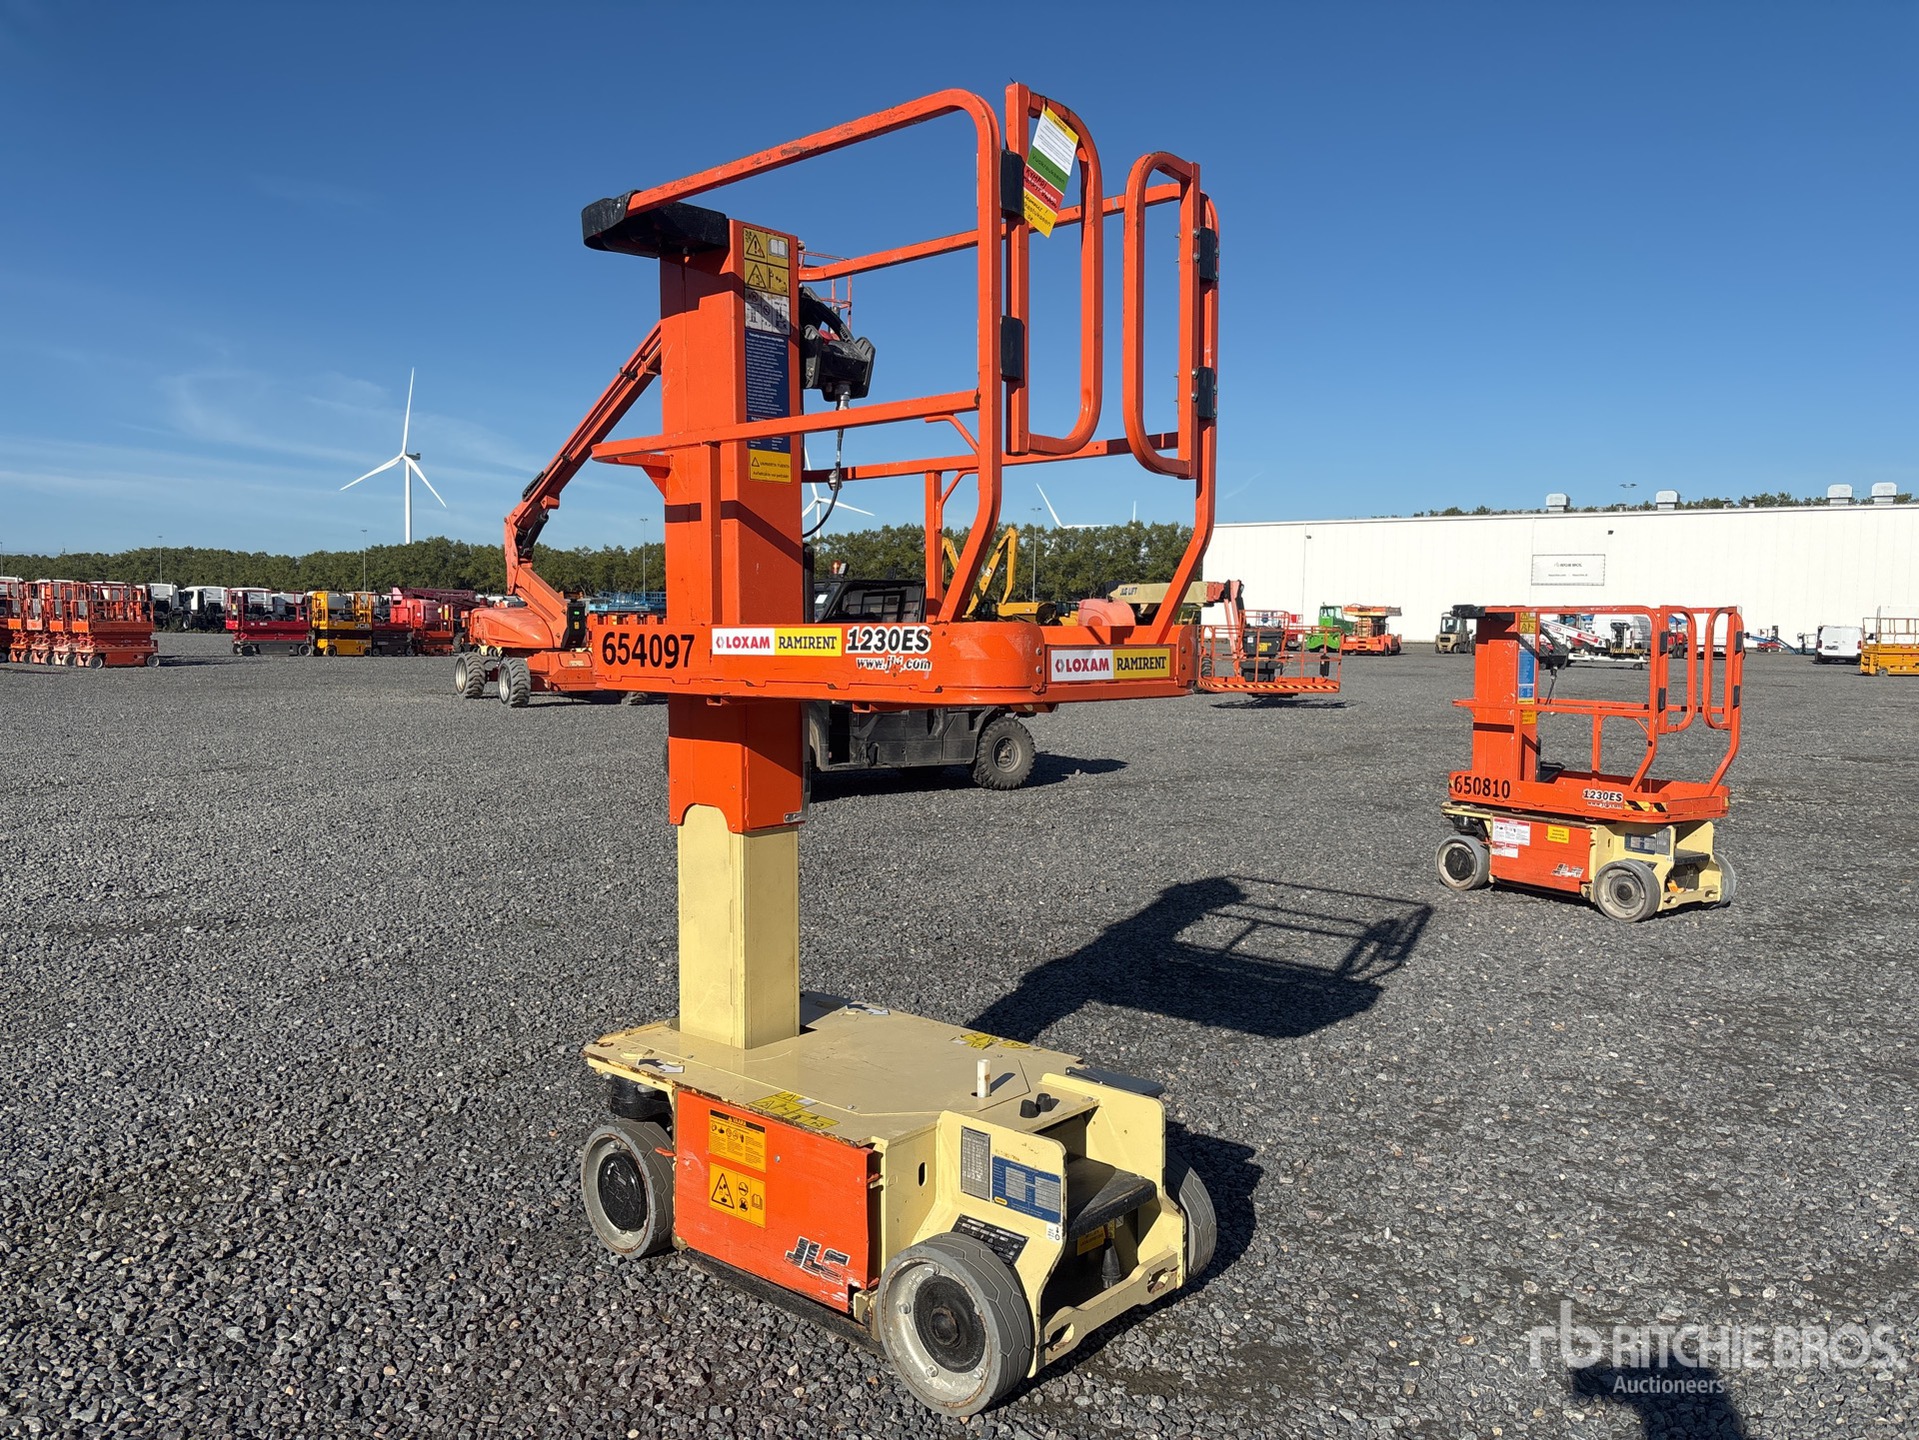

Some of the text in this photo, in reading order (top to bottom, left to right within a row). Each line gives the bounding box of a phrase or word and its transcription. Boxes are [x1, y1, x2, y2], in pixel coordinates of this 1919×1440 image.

[602, 631, 695, 669] 654097
[725, 635, 838, 650] LOXAM RAMIRENT
[847, 628, 931, 652] 1230ES
[1066, 656, 1167, 672] LOXAM RAMIRENT
[1454, 775, 1511, 799] 650810
[1584, 789, 1622, 802] 1230ES
